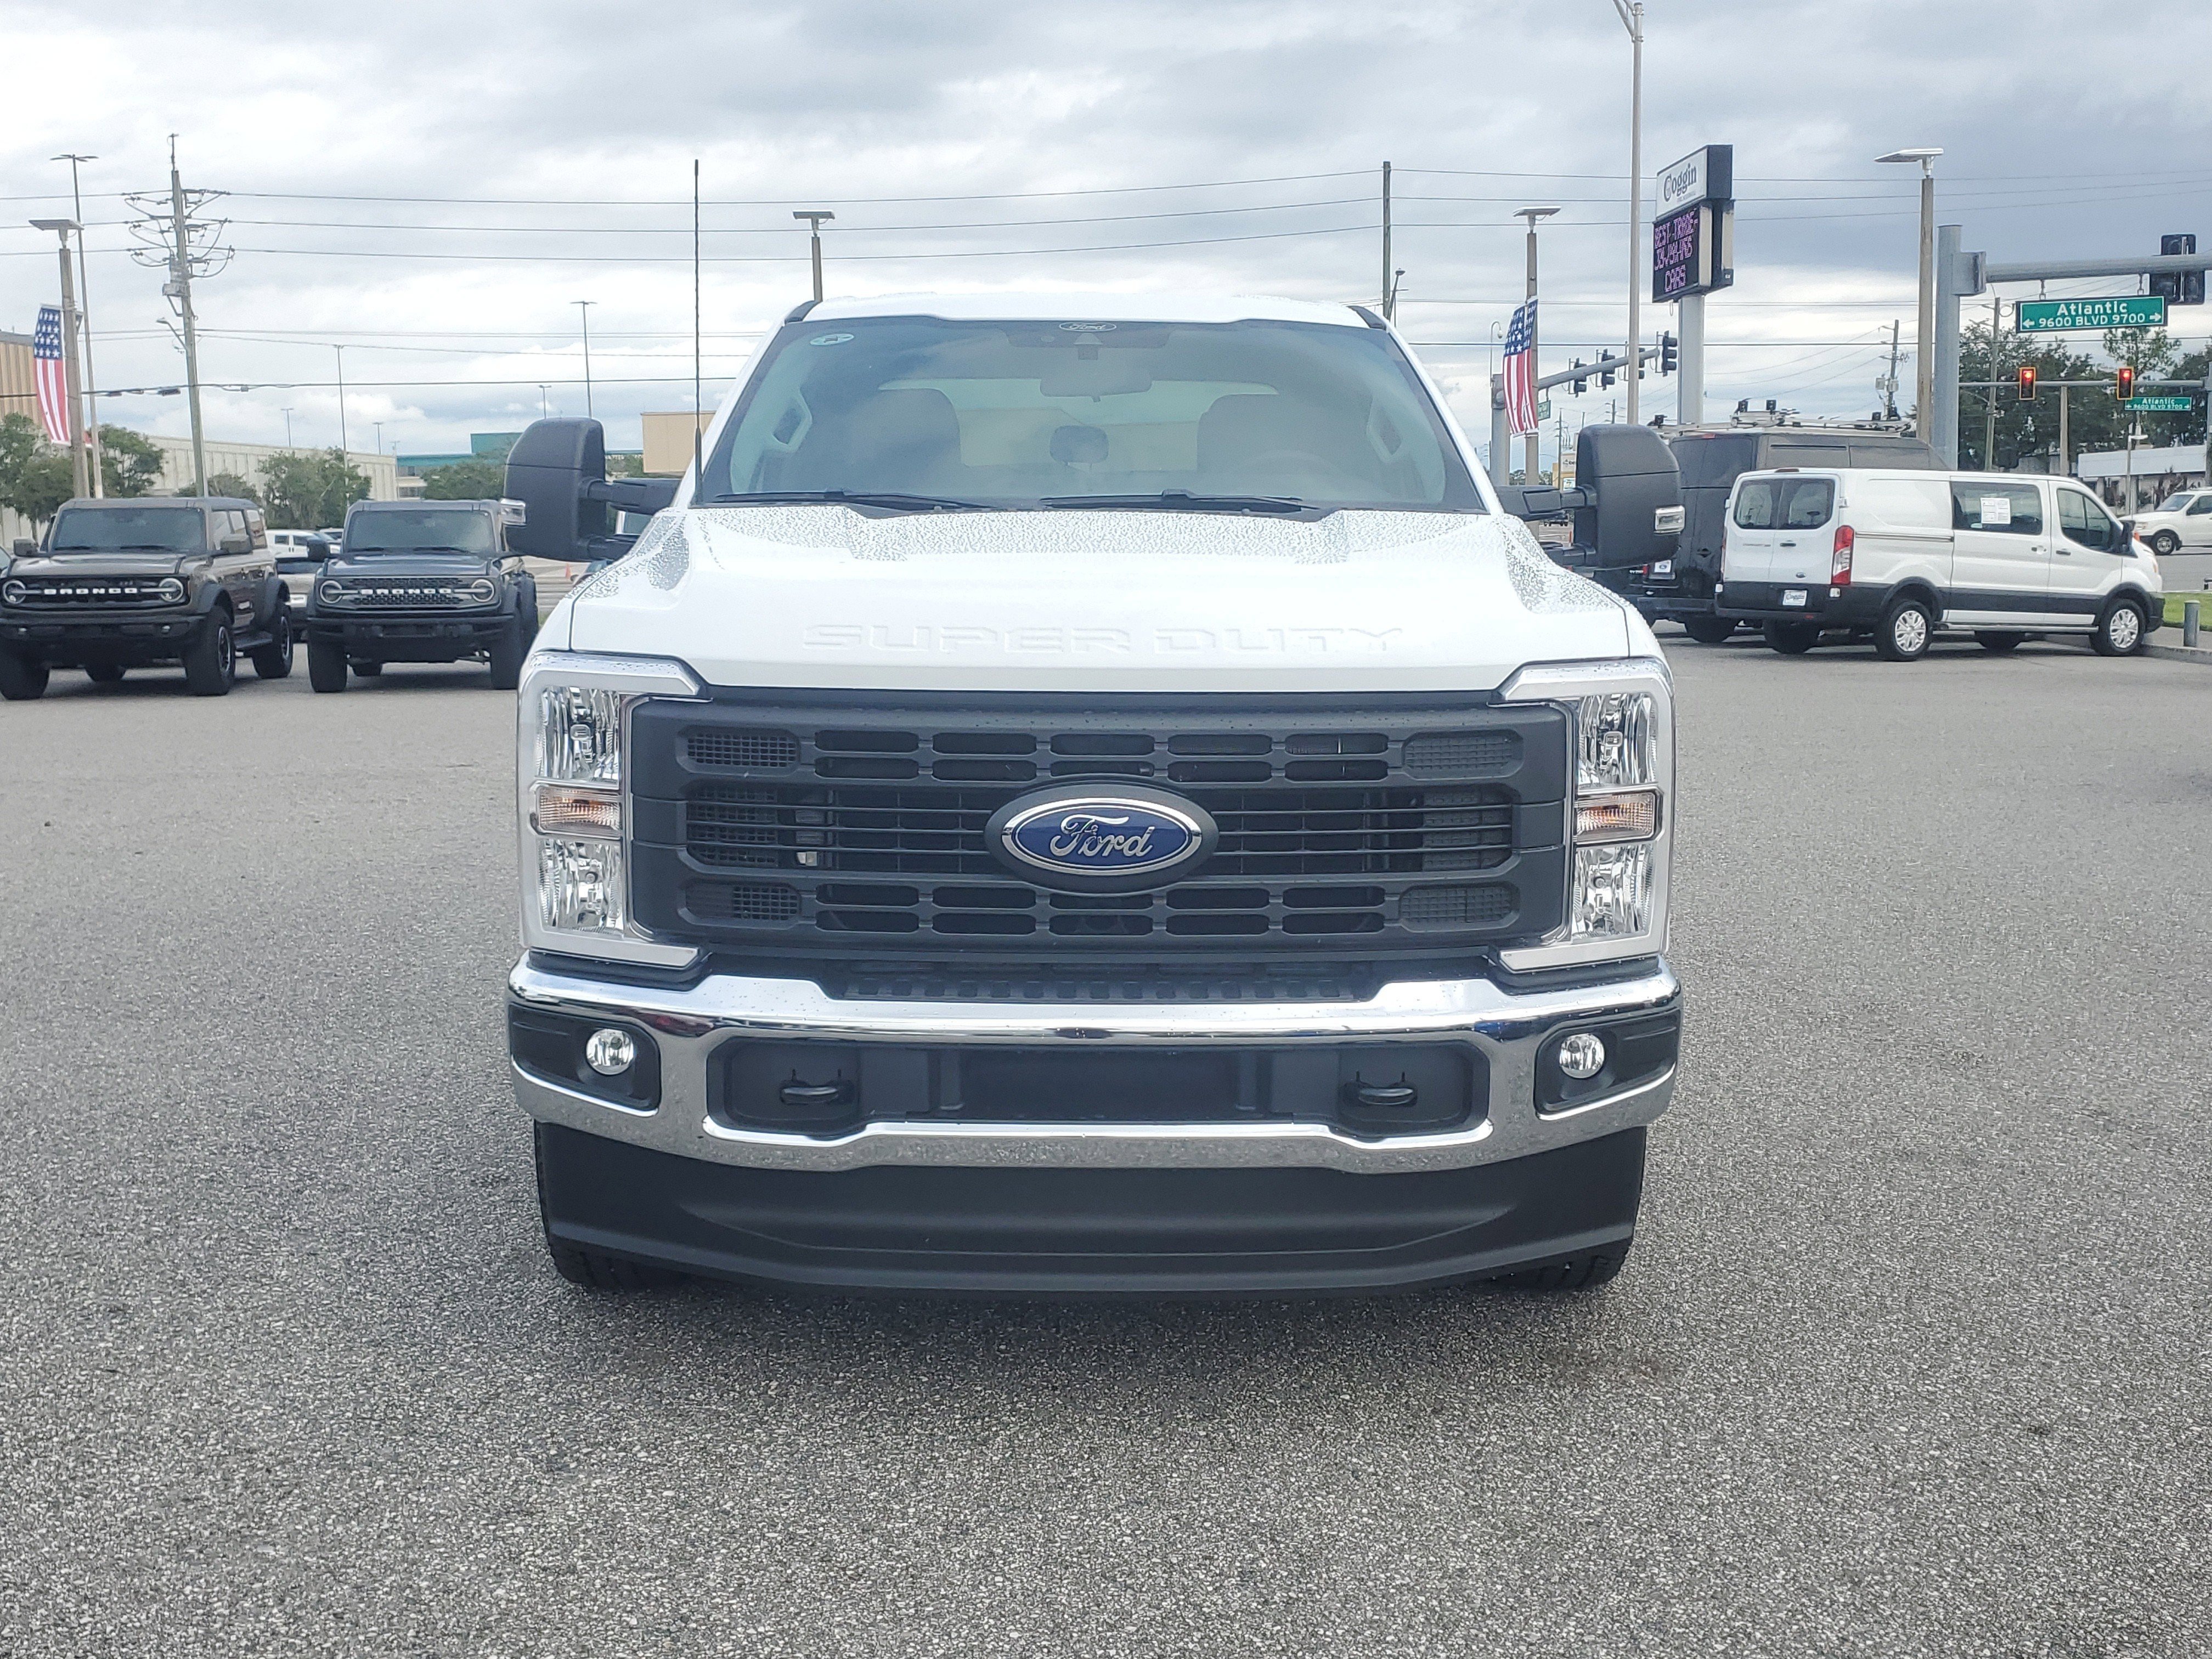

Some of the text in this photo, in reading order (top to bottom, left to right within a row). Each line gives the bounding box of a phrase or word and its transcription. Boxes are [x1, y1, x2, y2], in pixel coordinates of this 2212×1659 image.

[1664, 163, 1697, 202] Coggin
[2057, 301, 2128, 316] Atlantic
[1069, 323, 1107, 331] Ford
[2039, 313, 2145, 328] 9600 BLVD 9700
[802, 624, 1404, 653] SUPER DUTY
[1050, 814, 1155, 857] Ford
